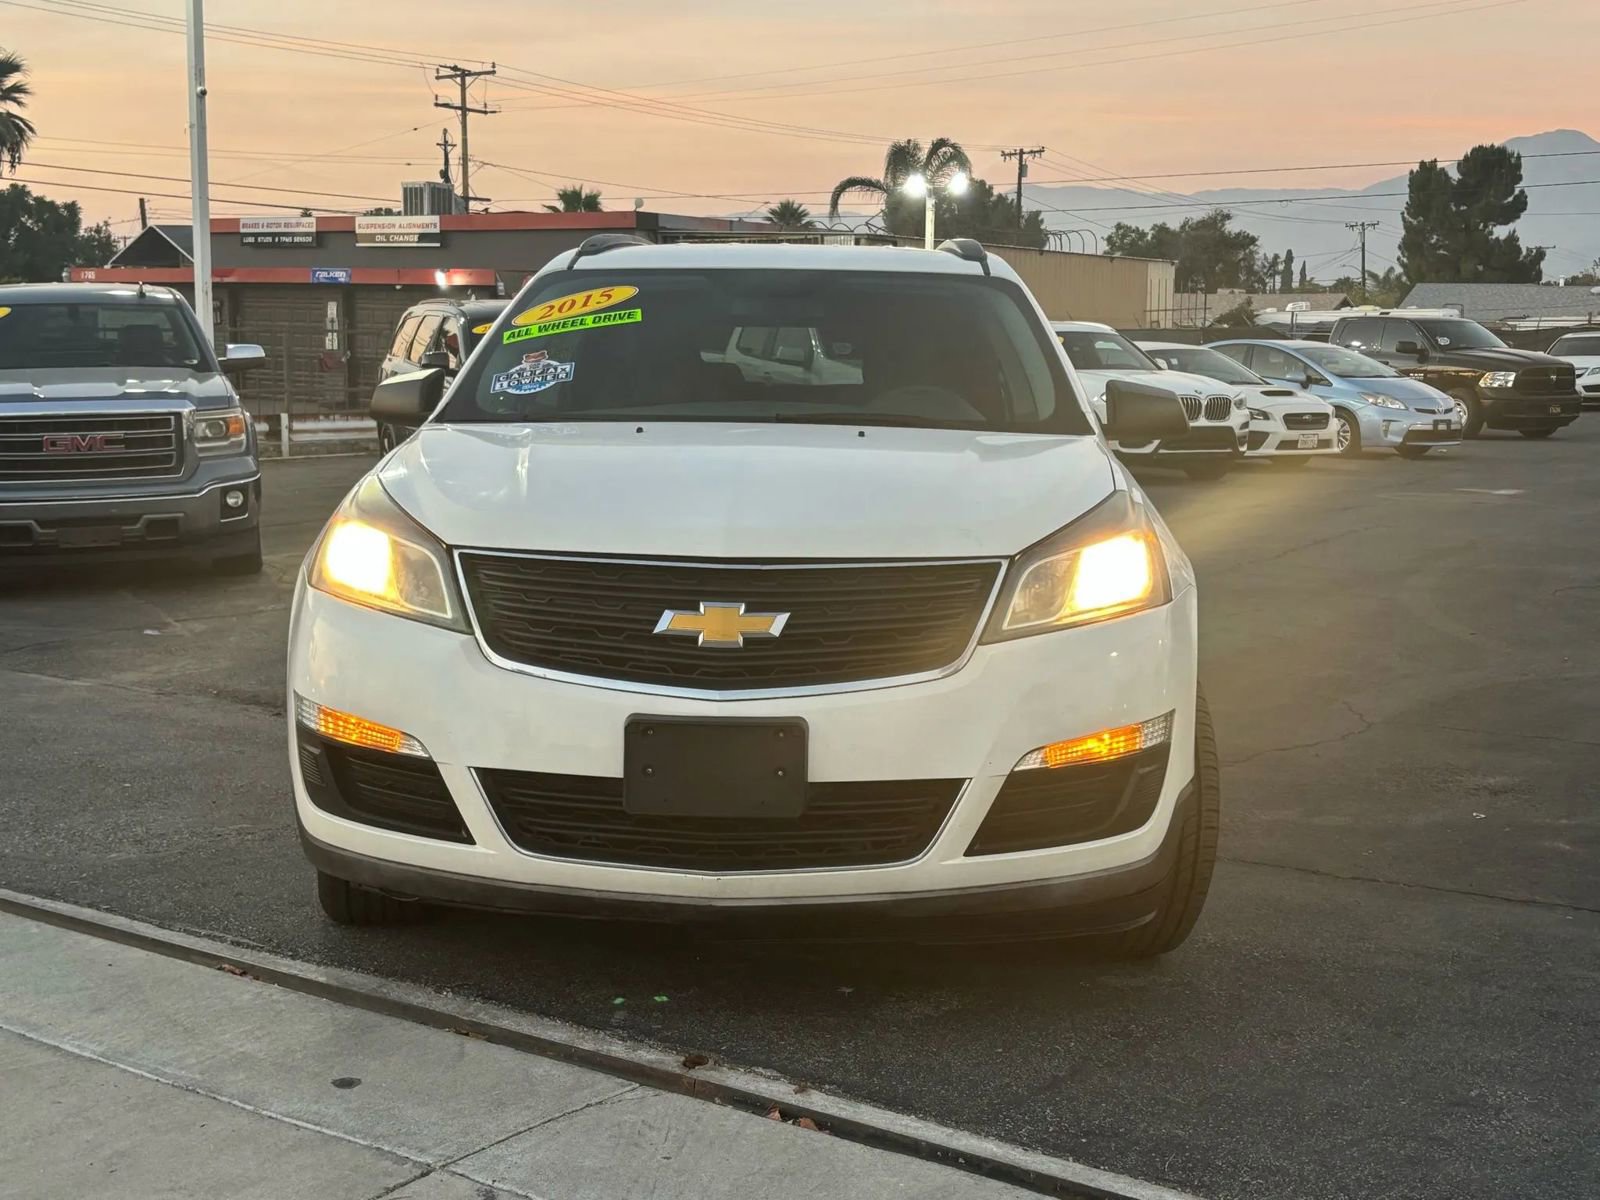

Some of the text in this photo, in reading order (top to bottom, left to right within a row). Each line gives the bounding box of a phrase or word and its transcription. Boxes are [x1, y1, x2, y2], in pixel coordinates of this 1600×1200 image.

[375, 234, 420, 242] OIL CHANGE
[535, 288, 615, 321] 2015
[506, 310, 638, 342] ALL WHEEL DRIVE
[498, 366, 569, 382] CARFAX
[509, 372, 567, 387] OWNER
[43, 434, 125, 454] GMC
